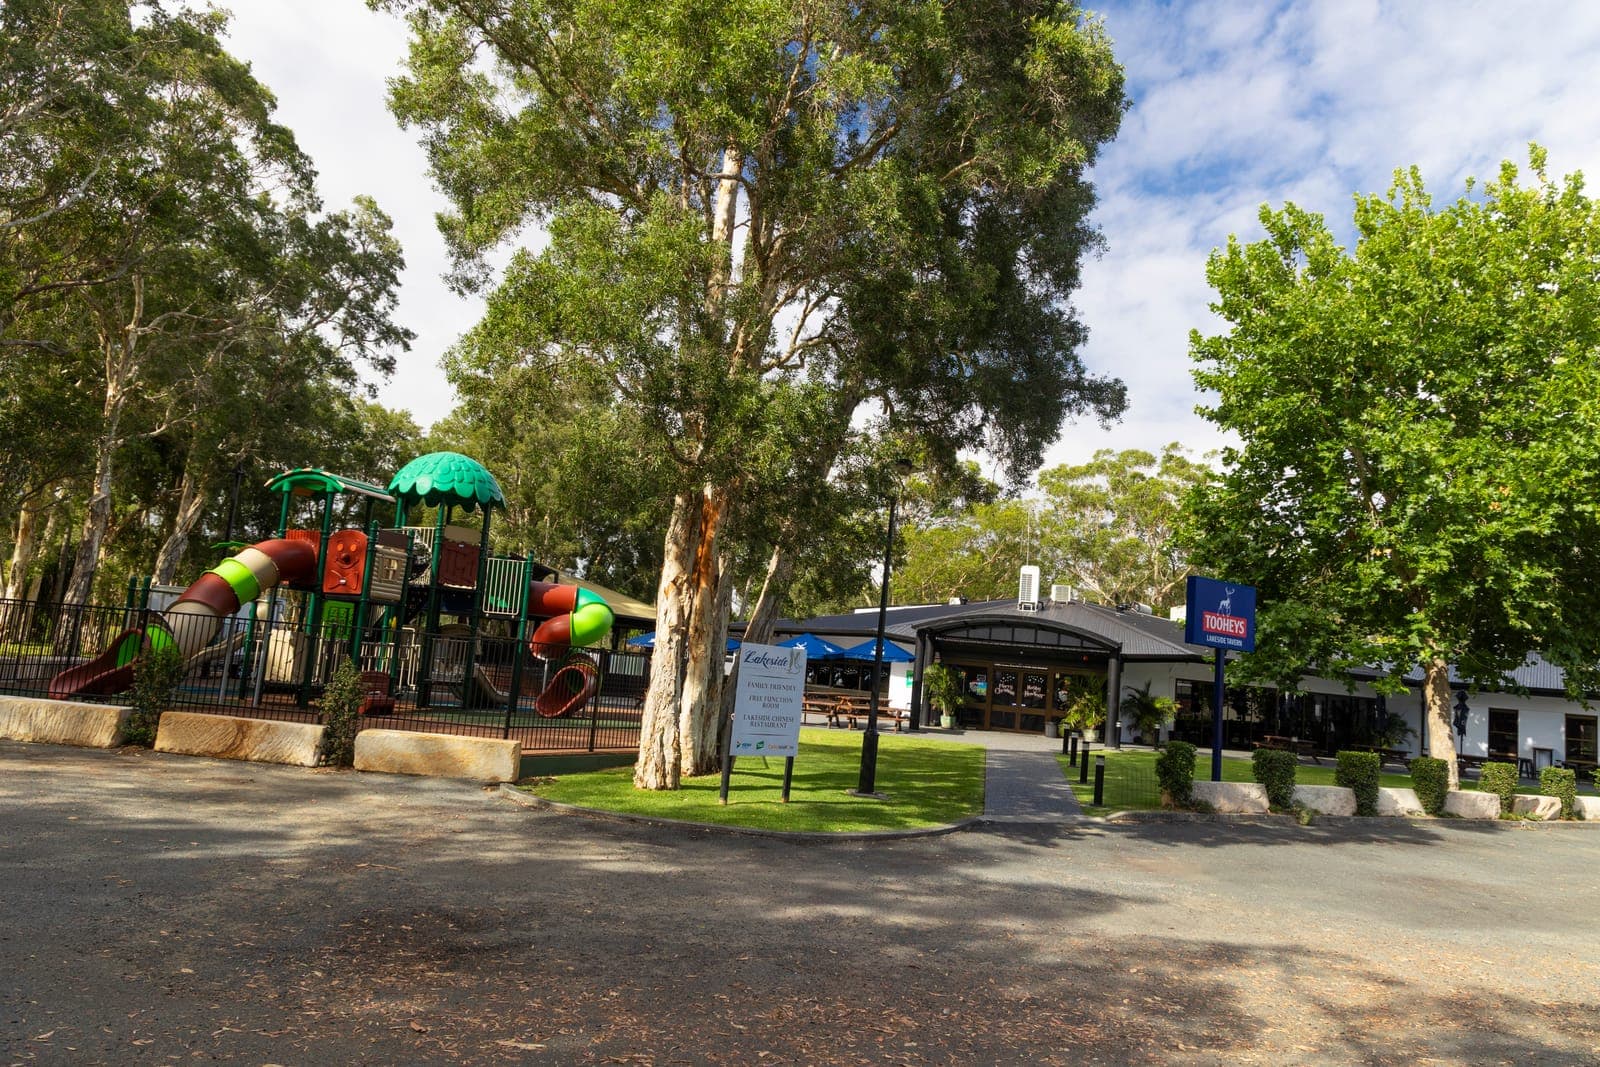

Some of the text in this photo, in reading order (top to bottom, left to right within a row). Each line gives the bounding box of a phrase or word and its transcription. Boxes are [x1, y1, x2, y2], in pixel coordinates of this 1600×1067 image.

[1204, 614, 1245, 634] TOOHEYS
[1206, 634, 1243, 647] LAKESIDE TAVERN
[744, 649, 788, 669] Lakeside
[747, 681, 796, 692] FAMILY FRIENDLY
[764, 696, 793, 704] FUNCTION
[743, 714, 771, 722] LAKESIDE
[750, 721, 788, 729] RESTAURANT
